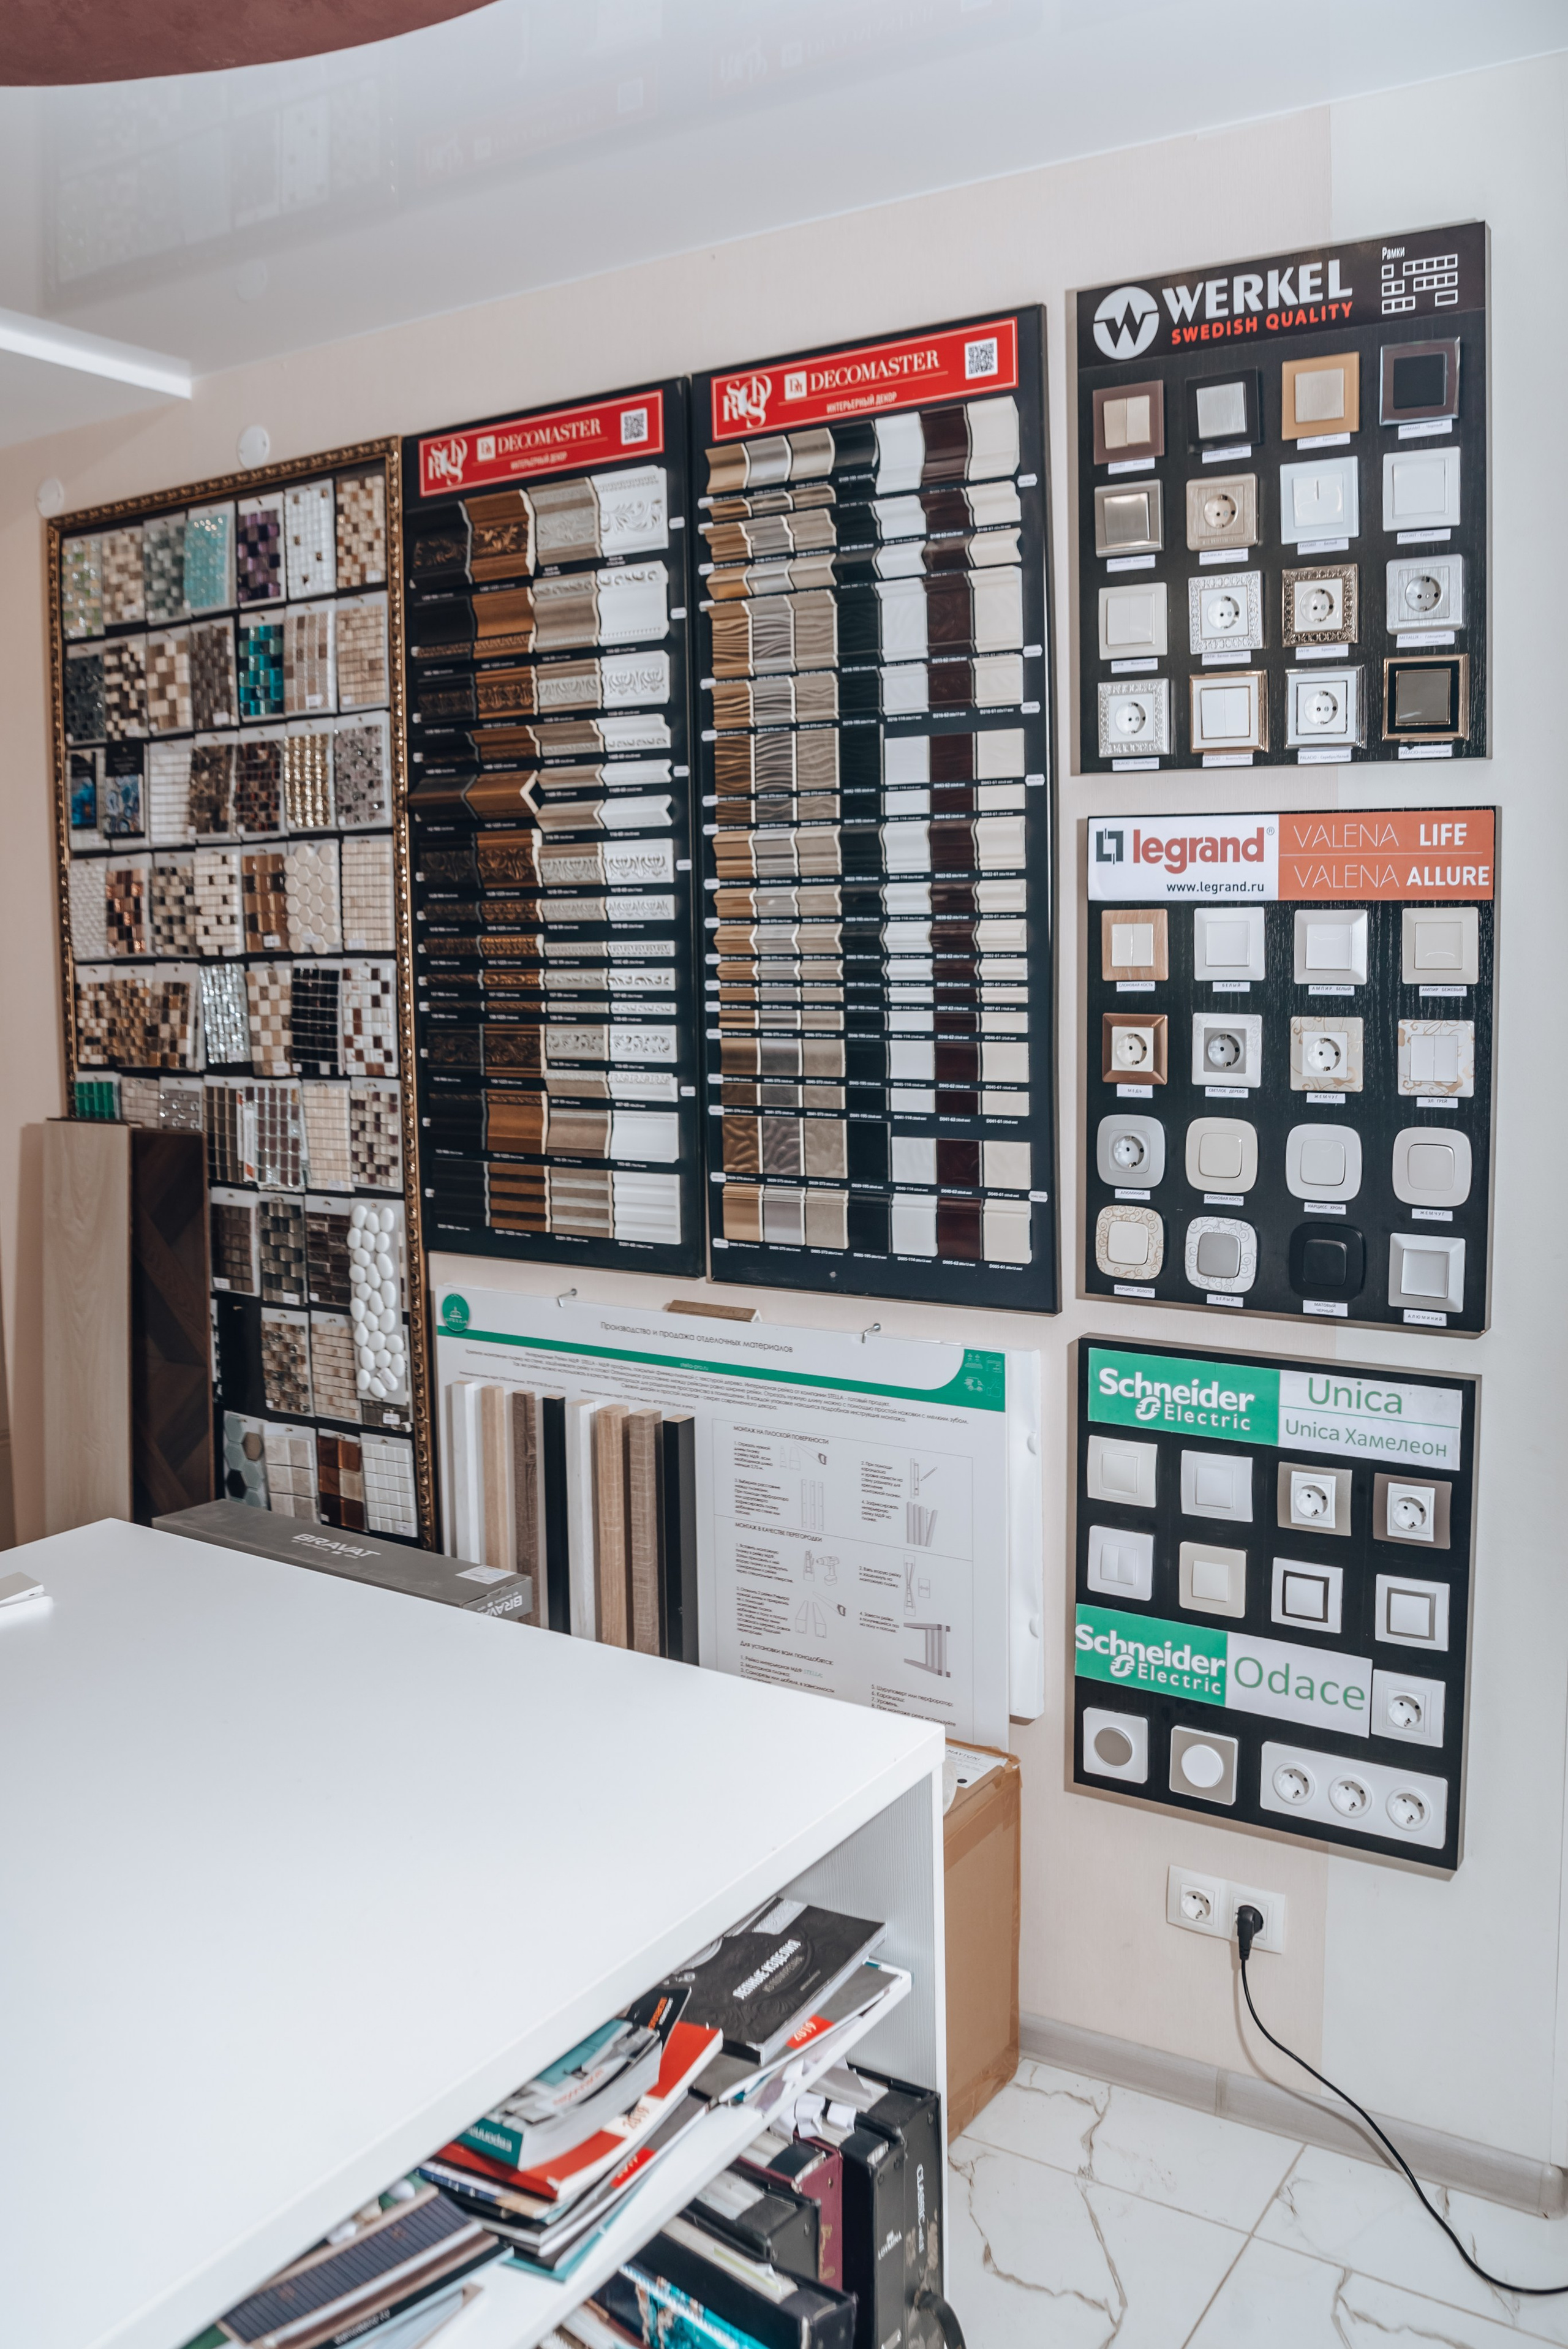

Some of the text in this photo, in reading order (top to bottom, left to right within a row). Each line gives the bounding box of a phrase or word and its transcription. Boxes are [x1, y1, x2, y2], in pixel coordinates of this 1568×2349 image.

[1382, 246, 1404, 260] Рамки
[1163, 259, 1353, 325] WERKEL
[1172, 301, 1353, 345] SWEDISH QUALITY
[810, 350, 940, 392] DECOMASTER
[826, 391, 897, 414] ИНТЕРЬЕРНЫЙ ДЕКОР
[498, 418, 602, 454] DECOMASTER
[1133, 827, 1264, 874] legrand
[1293, 823, 1467, 848] VALENA LIFE
[1166, 881, 1264, 894] www.legrand.ru
[1294, 864, 1490, 889] VALENA ALLURE
[600, 1321, 650, 1335] Производство
[660, 1330, 695, 1341] продажа
[697, 1335, 741, 1347] отделочных
[743, 1341, 793, 1353] материалов
[1099, 1367, 1255, 1412] Schneider
[1308, 1377, 1402, 1415] Unica
[1164, 1403, 1251, 1431] Electric
[765, 1430, 791, 1439] ПЛОСКОЙ
[1286, 1419, 1447, 1458] Unica Хамелеон
[293, 1534, 382, 1556] BRAVAT
[1075, 1624, 1226, 1677] Schneider
[1137, 1662, 1222, 1695] Electric
[1234, 1656, 1365, 1711] Odace
[733, 1969, 770, 2000] ЛЕПНЫЕ
[761, 1939, 801, 1973] ИЗДЕЛИЯ
[794, 2021, 816, 2042] 2019
